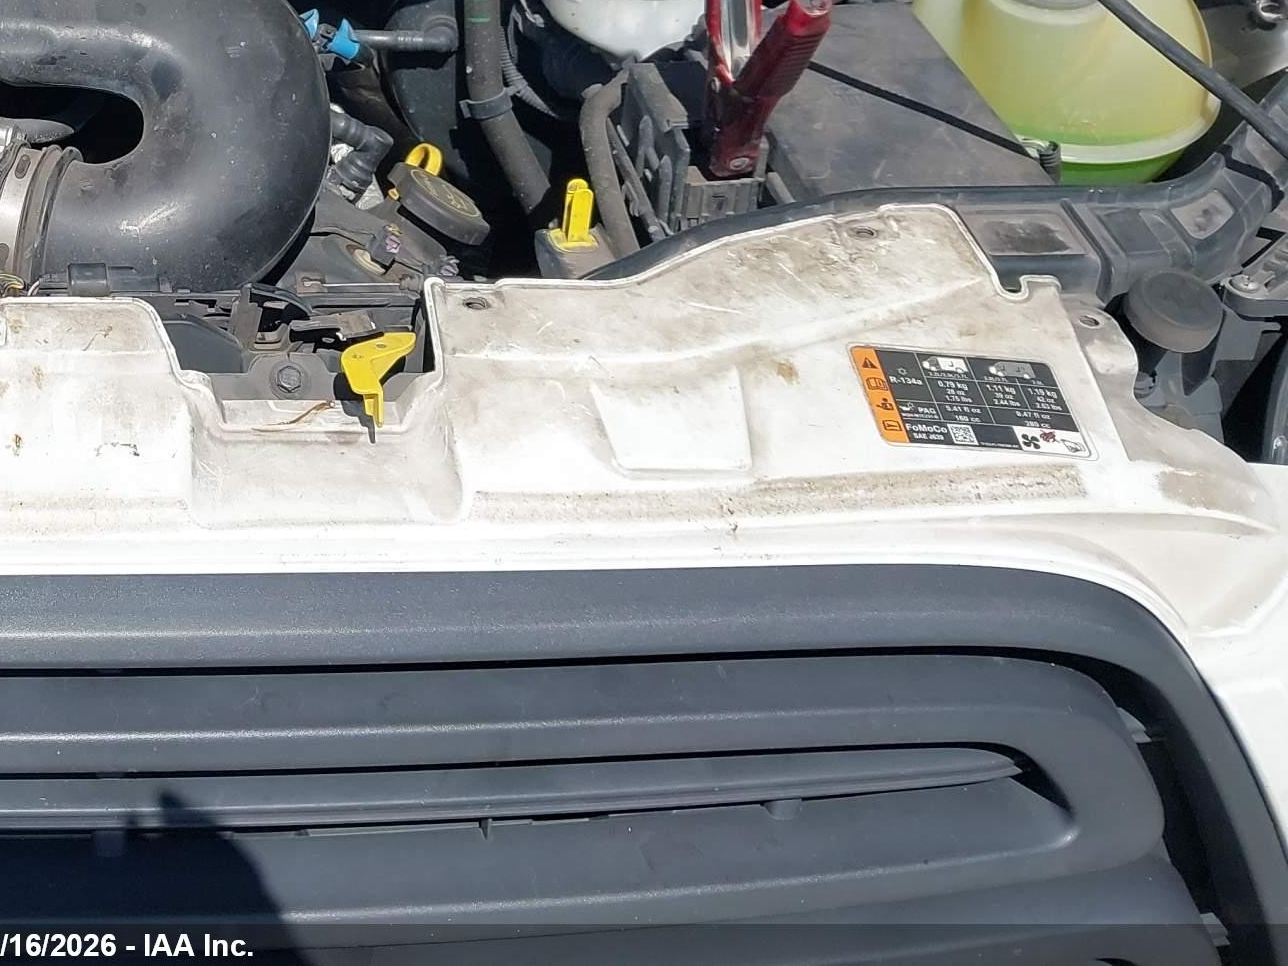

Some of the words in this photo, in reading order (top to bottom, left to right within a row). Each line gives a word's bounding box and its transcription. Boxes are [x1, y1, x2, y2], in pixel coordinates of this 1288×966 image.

[888, 376, 923, 386] R-134a
[937, 380, 955, 388] 0.79
[956, 382, 969, 391] kg
[986, 384, 1003, 393] 1.11
[1004, 385, 1016, 395] kg
[1045, 389, 1058, 399] kg
[918, 406, 936, 414] PAG
[905, 423, 948, 433] FoMoCo
